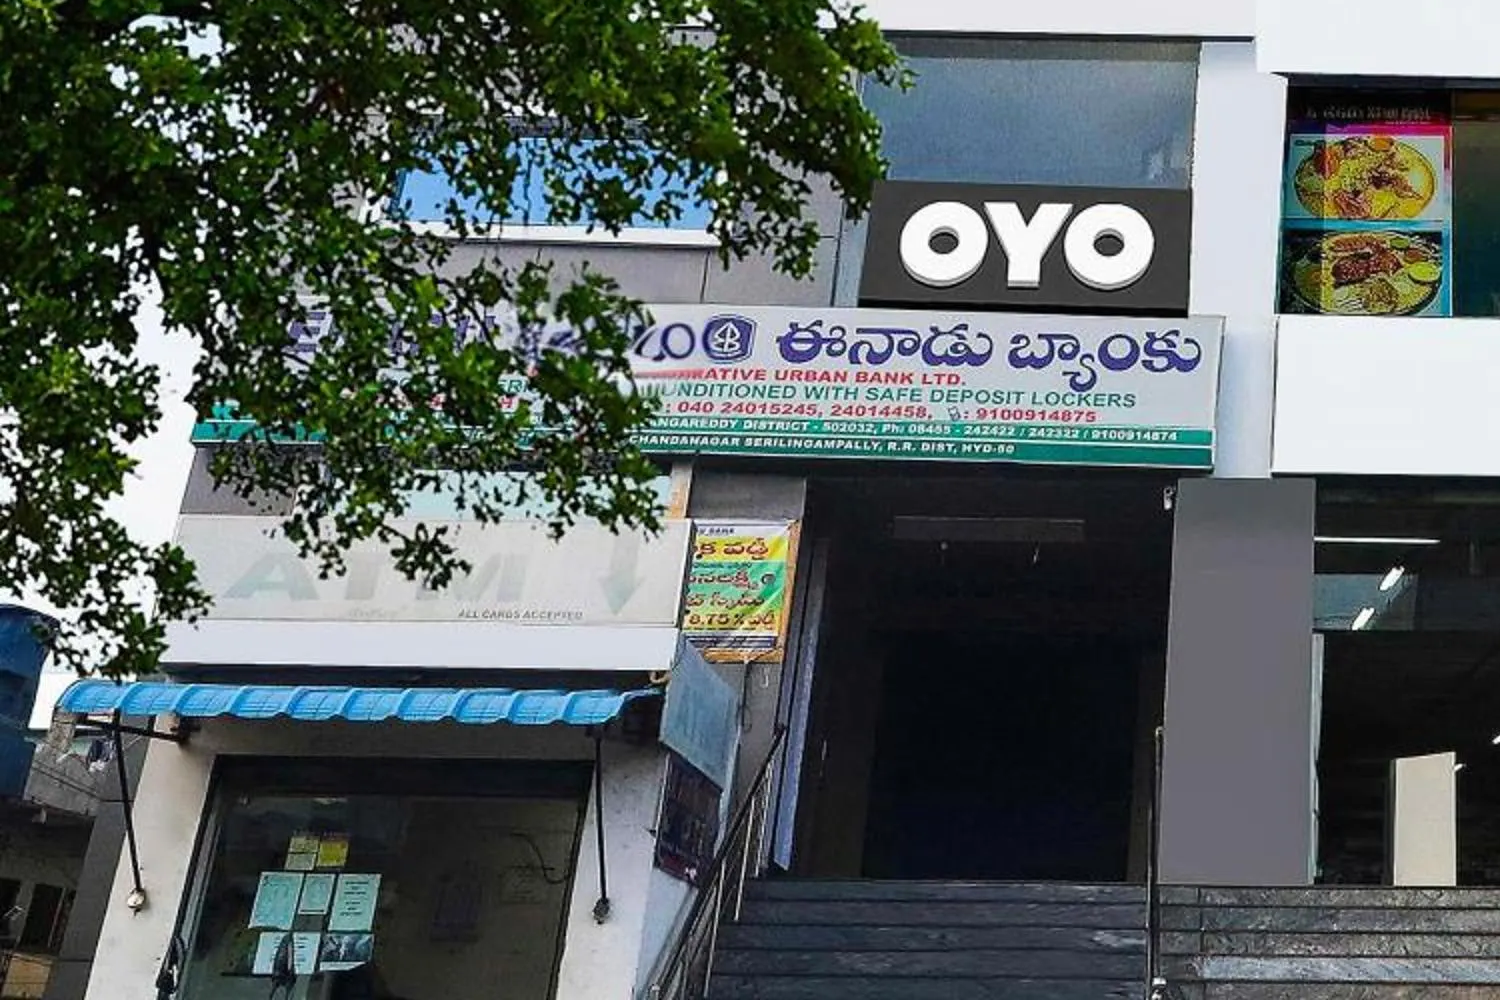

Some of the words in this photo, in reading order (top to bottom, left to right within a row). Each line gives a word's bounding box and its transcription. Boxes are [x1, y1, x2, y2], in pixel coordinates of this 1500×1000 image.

[899, 201, 1155, 292] OYO
[775, 319, 994, 367] ఈనాడు
[1007, 328, 1202, 393] బ్యాంకు
[696, 368, 767, 382] ATIVE
[774, 369, 848, 383] URBAN
[855, 371, 913, 384] BANK
[921, 373, 967, 386] LTD.
[665, 383, 796, 399] NDITIONED
[804, 385, 859, 400] WITH
[865, 387, 923, 402] SAFE
[929, 389, 1026, 405] DEPOSIT
[1031, 391, 1137, 408] LOCKERS
[677, 401, 715, 413] 040
[719, 402, 824, 417] 24015245,
[830, 404, 934, 420] 24014458,
[975, 407, 1097, 422] 9100914875
[743, 419, 809, 432] DISTRICT
[628, 433, 741, 447] CHANDANAGAR
[887, 441, 917, 451] R.R.
[458, 608, 478, 619] ALL
